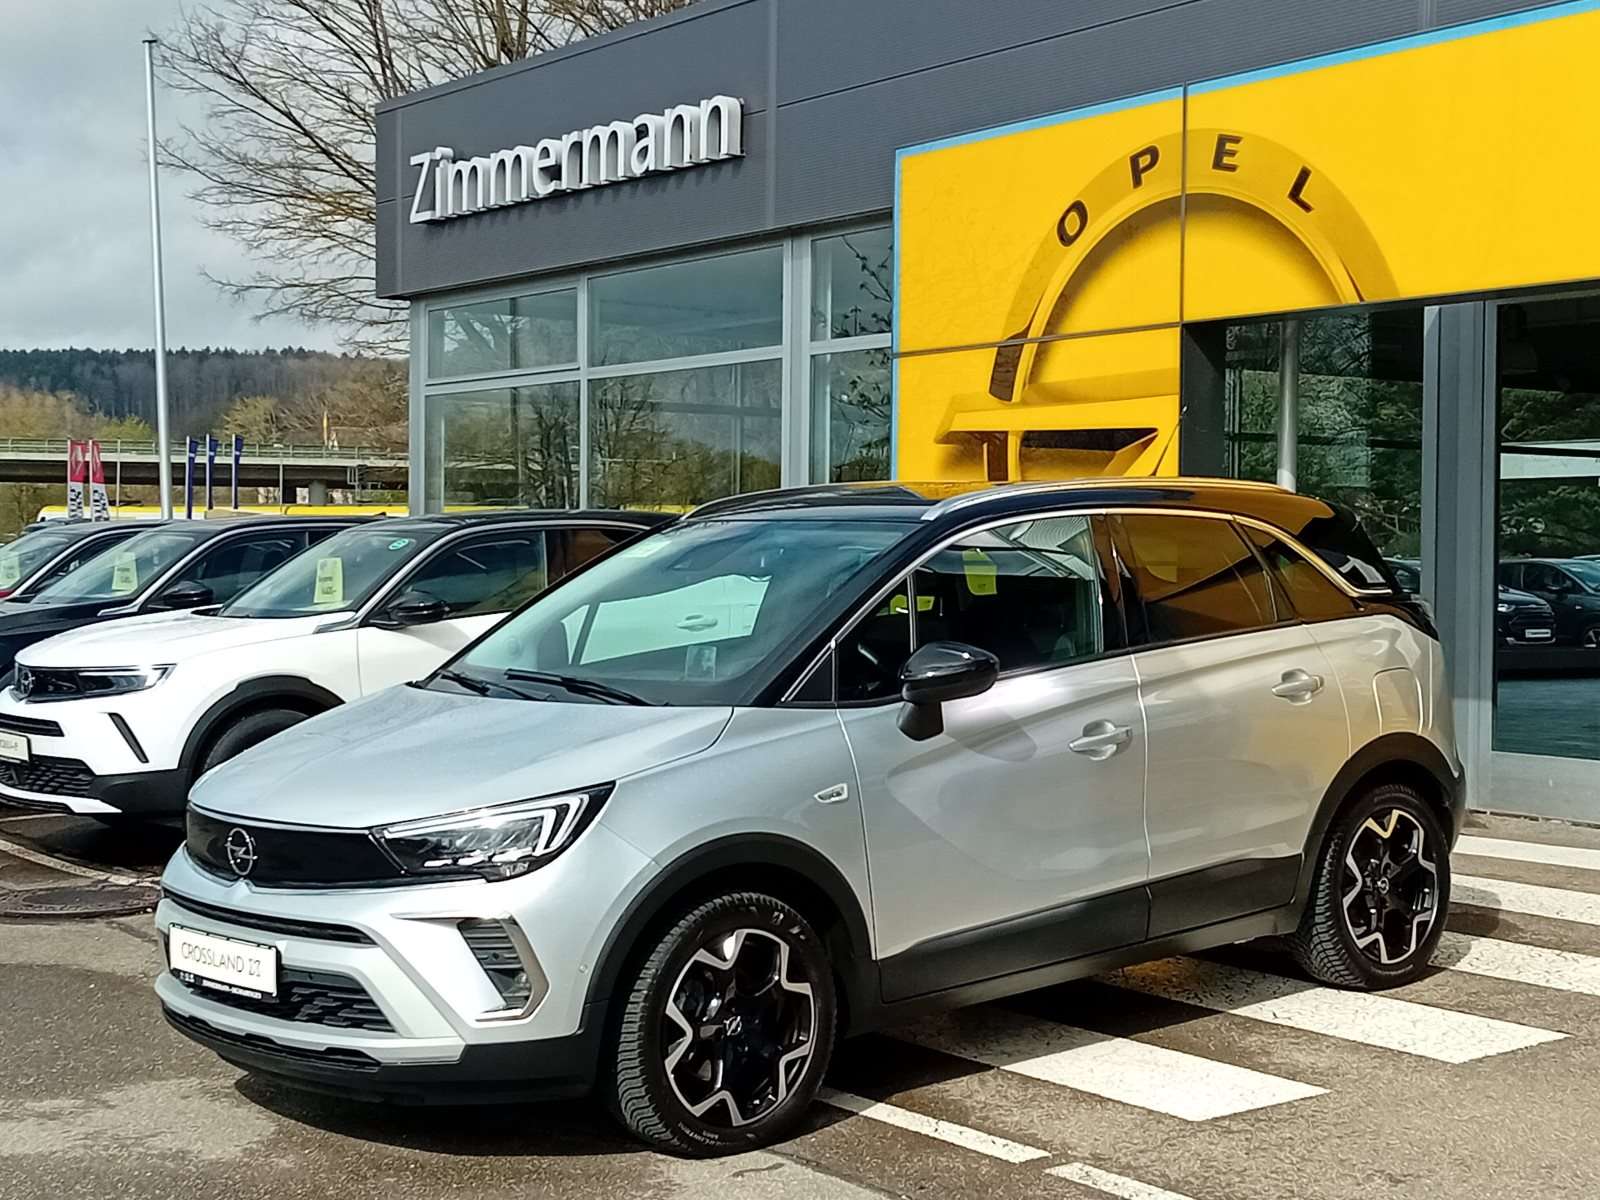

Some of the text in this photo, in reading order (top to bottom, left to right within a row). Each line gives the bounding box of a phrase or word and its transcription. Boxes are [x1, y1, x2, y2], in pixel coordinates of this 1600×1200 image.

[409, 94, 745, 224] Zimmermann
[1056, 133, 1314, 247] OPEL
[181, 942, 245, 973] CROSSLAND
